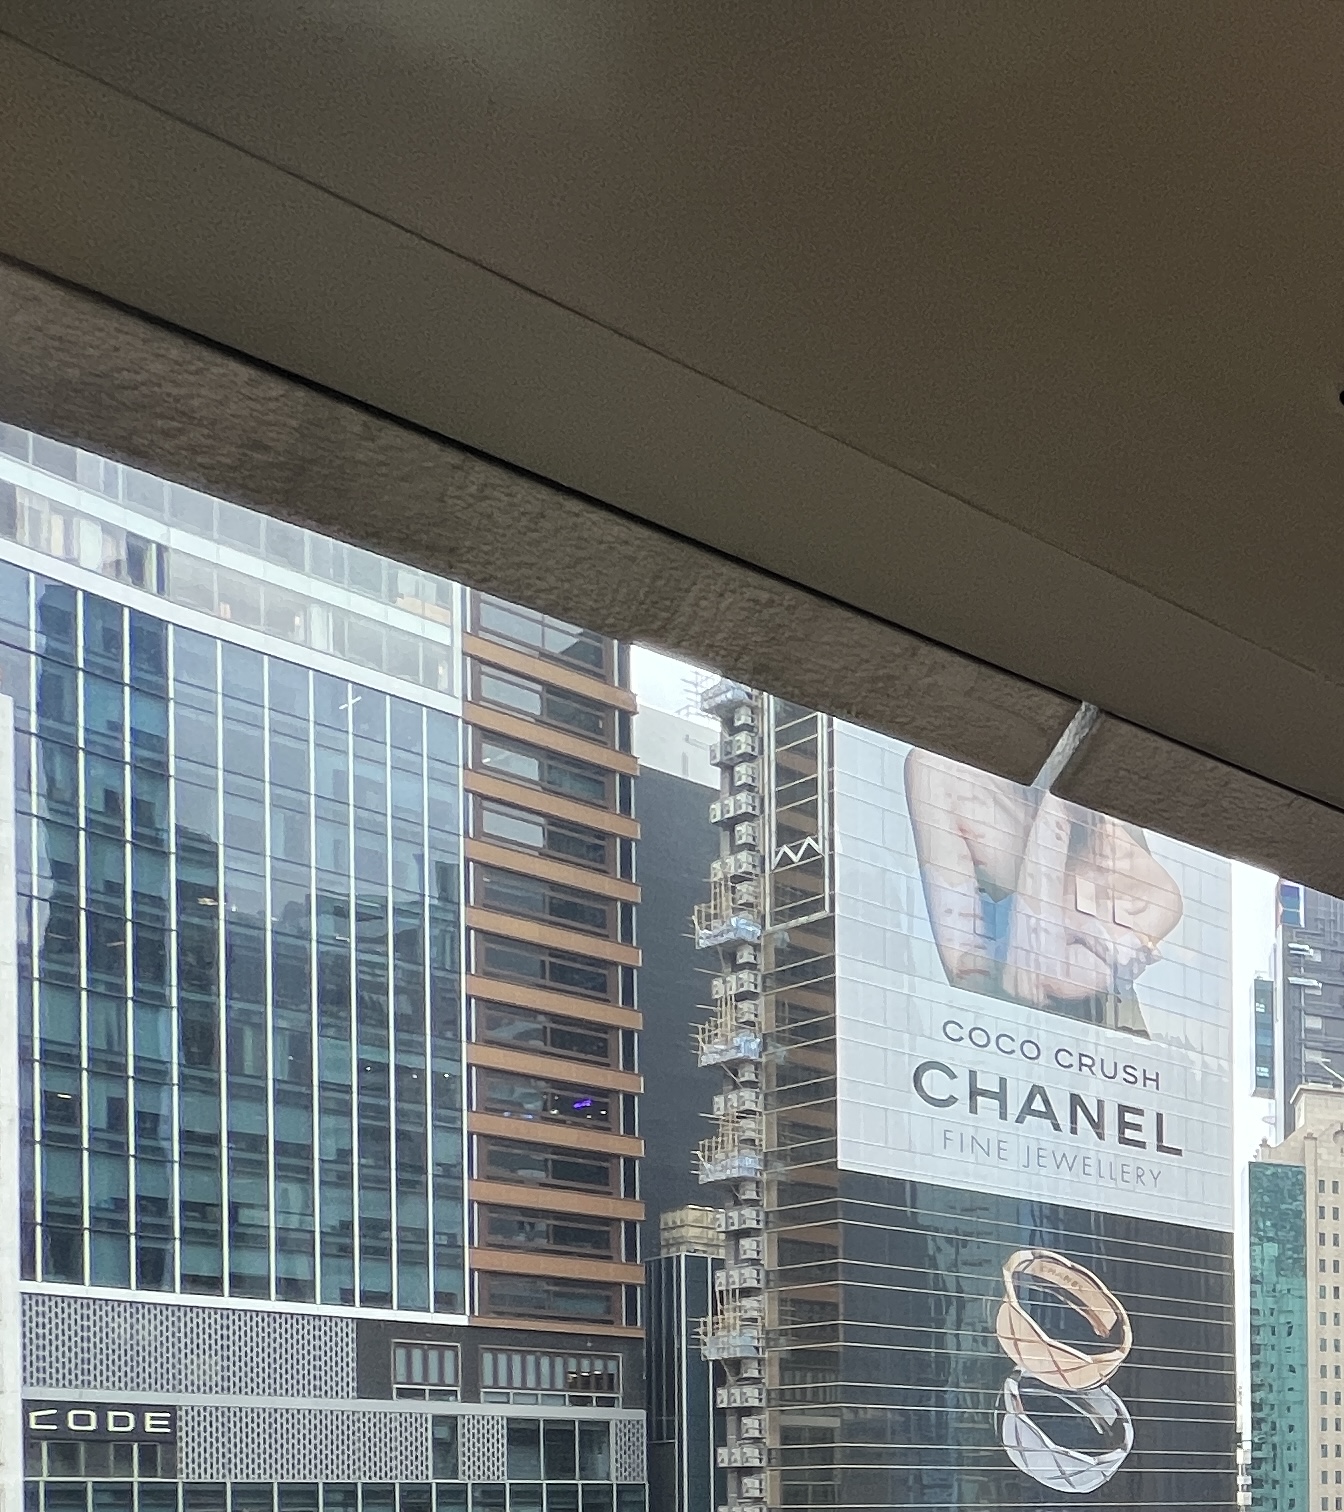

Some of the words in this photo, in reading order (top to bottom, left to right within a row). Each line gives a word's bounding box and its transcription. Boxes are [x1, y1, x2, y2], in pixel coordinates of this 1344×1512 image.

[942, 1020, 1041, 1060] COCO
[1054, 1048, 1160, 1091] CRUSH
[912, 1060, 1183, 1157] CHANEL
[943, 1129, 1008, 1162] FINE
[1022, 1144, 1162, 1189] JEWELLERY
[29, 1409, 171, 1433] CODE
